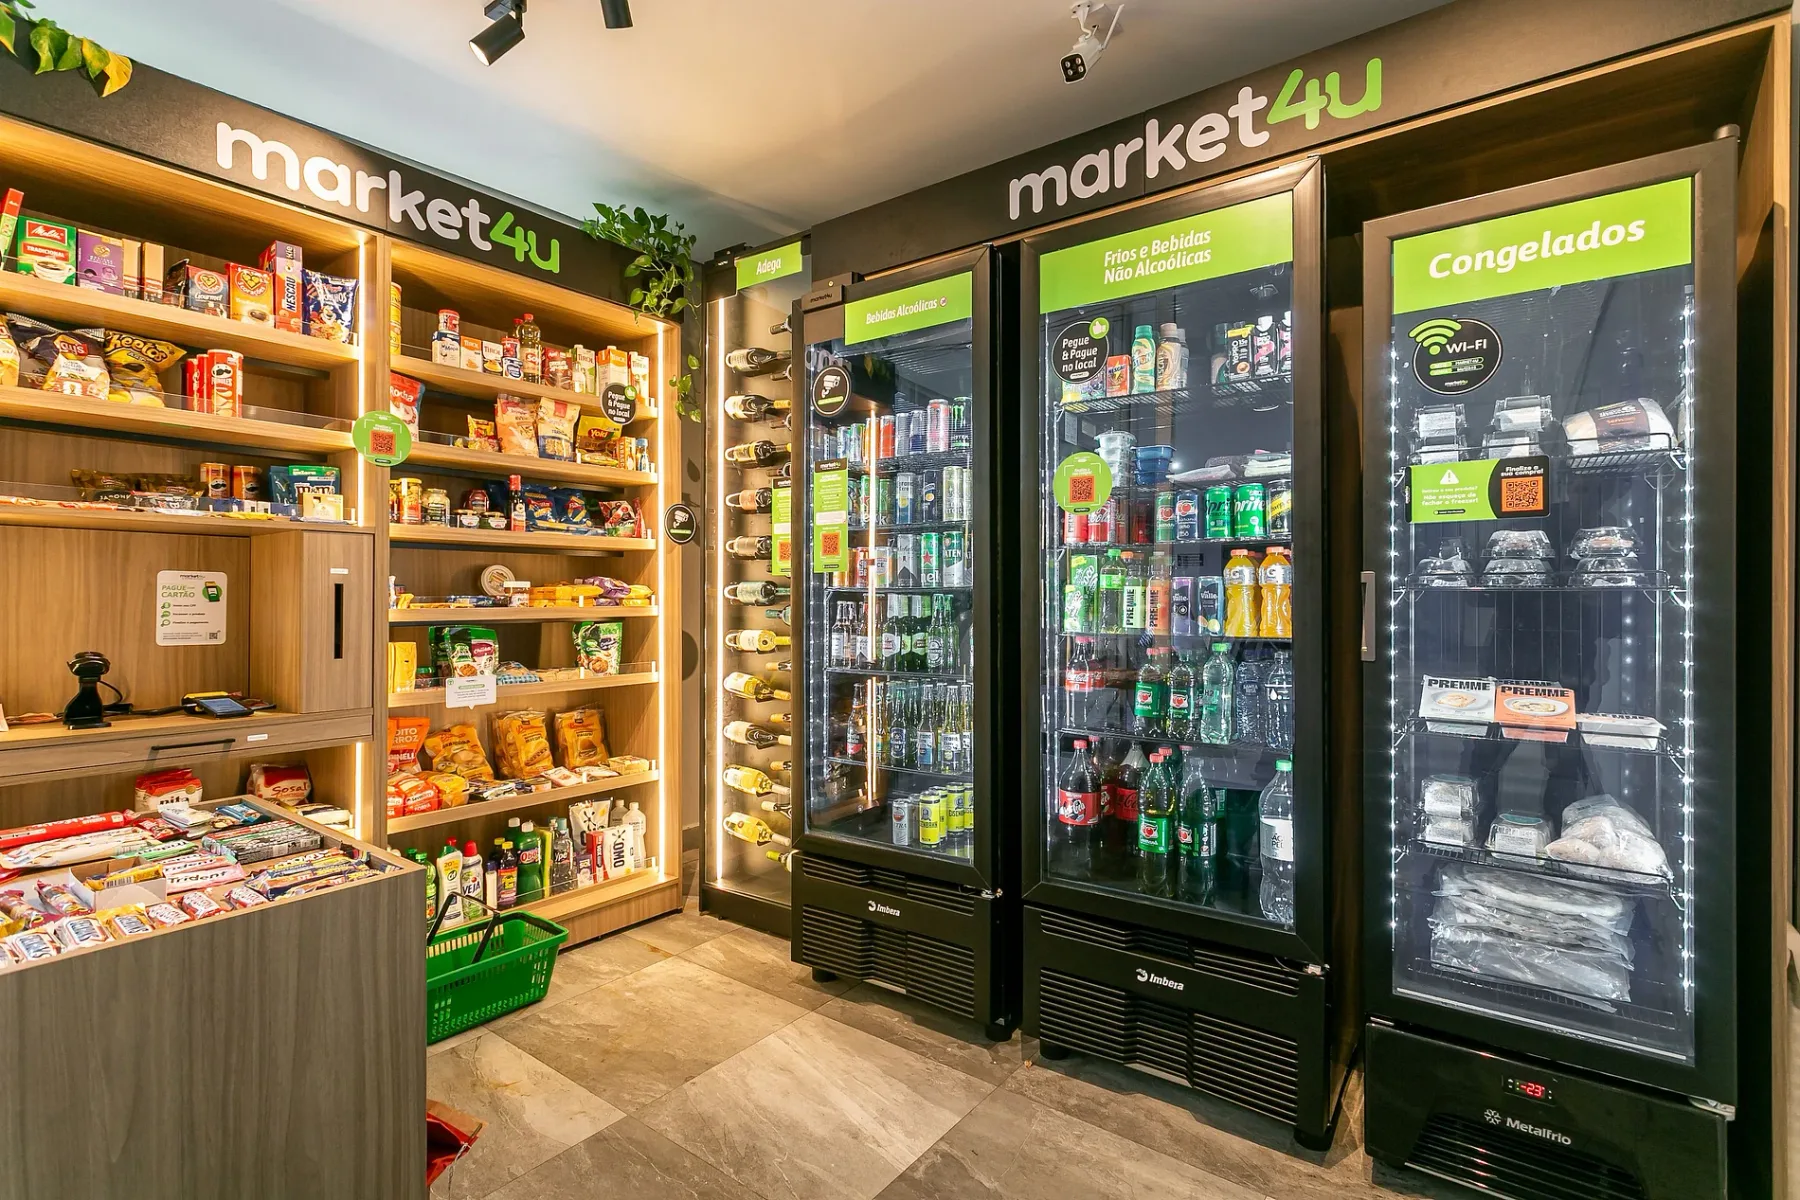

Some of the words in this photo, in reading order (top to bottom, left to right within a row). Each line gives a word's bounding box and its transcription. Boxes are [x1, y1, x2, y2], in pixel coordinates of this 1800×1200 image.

[1009, 57, 1383, 221] market4u
[216, 121, 560, 275] market4u
[1104, 248, 1137, 267] Frios
[1139, 245, 1149, 259] e
[1151, 229, 1212, 255] Bebidas
[1428, 219, 1646, 279] Congelados
[756, 257, 782, 275] Adega
[1103, 264, 1133, 285] Não
[1135, 248, 1212, 279] Alcoólicas
[285, 276, 297, 313] NESCAU
[865, 308, 897, 325] Bebidas
[896, 297, 938, 317] Alcoólicas
[60, 341, 85, 355] ay's
[108, 331, 168, 363] heetos
[1062, 336, 1090, 349] Pegue
[1062, 351, 1069, 360] &
[1070, 346, 1098, 360] Pague
[1062, 363, 1074, 372] no
[1075, 357, 1097, 370] local
[608, 391, 626, 401] Pegue
[613, 400, 631, 410] Pague
[616, 410, 630, 418] local
[1234, 496, 1266, 516] prite
[1427, 678, 1491, 692] PREMME
[1500, 685, 1570, 698] PREMME
[613, 842, 625, 869] OMO
[168, 869, 228, 884] Trident
[462, 882, 481, 895] VEJA
[877, 904, 900, 918] Imbera
[1148, 972, 1185, 992] Imbera
[1506, 1116, 1572, 1146] Metalfrio
